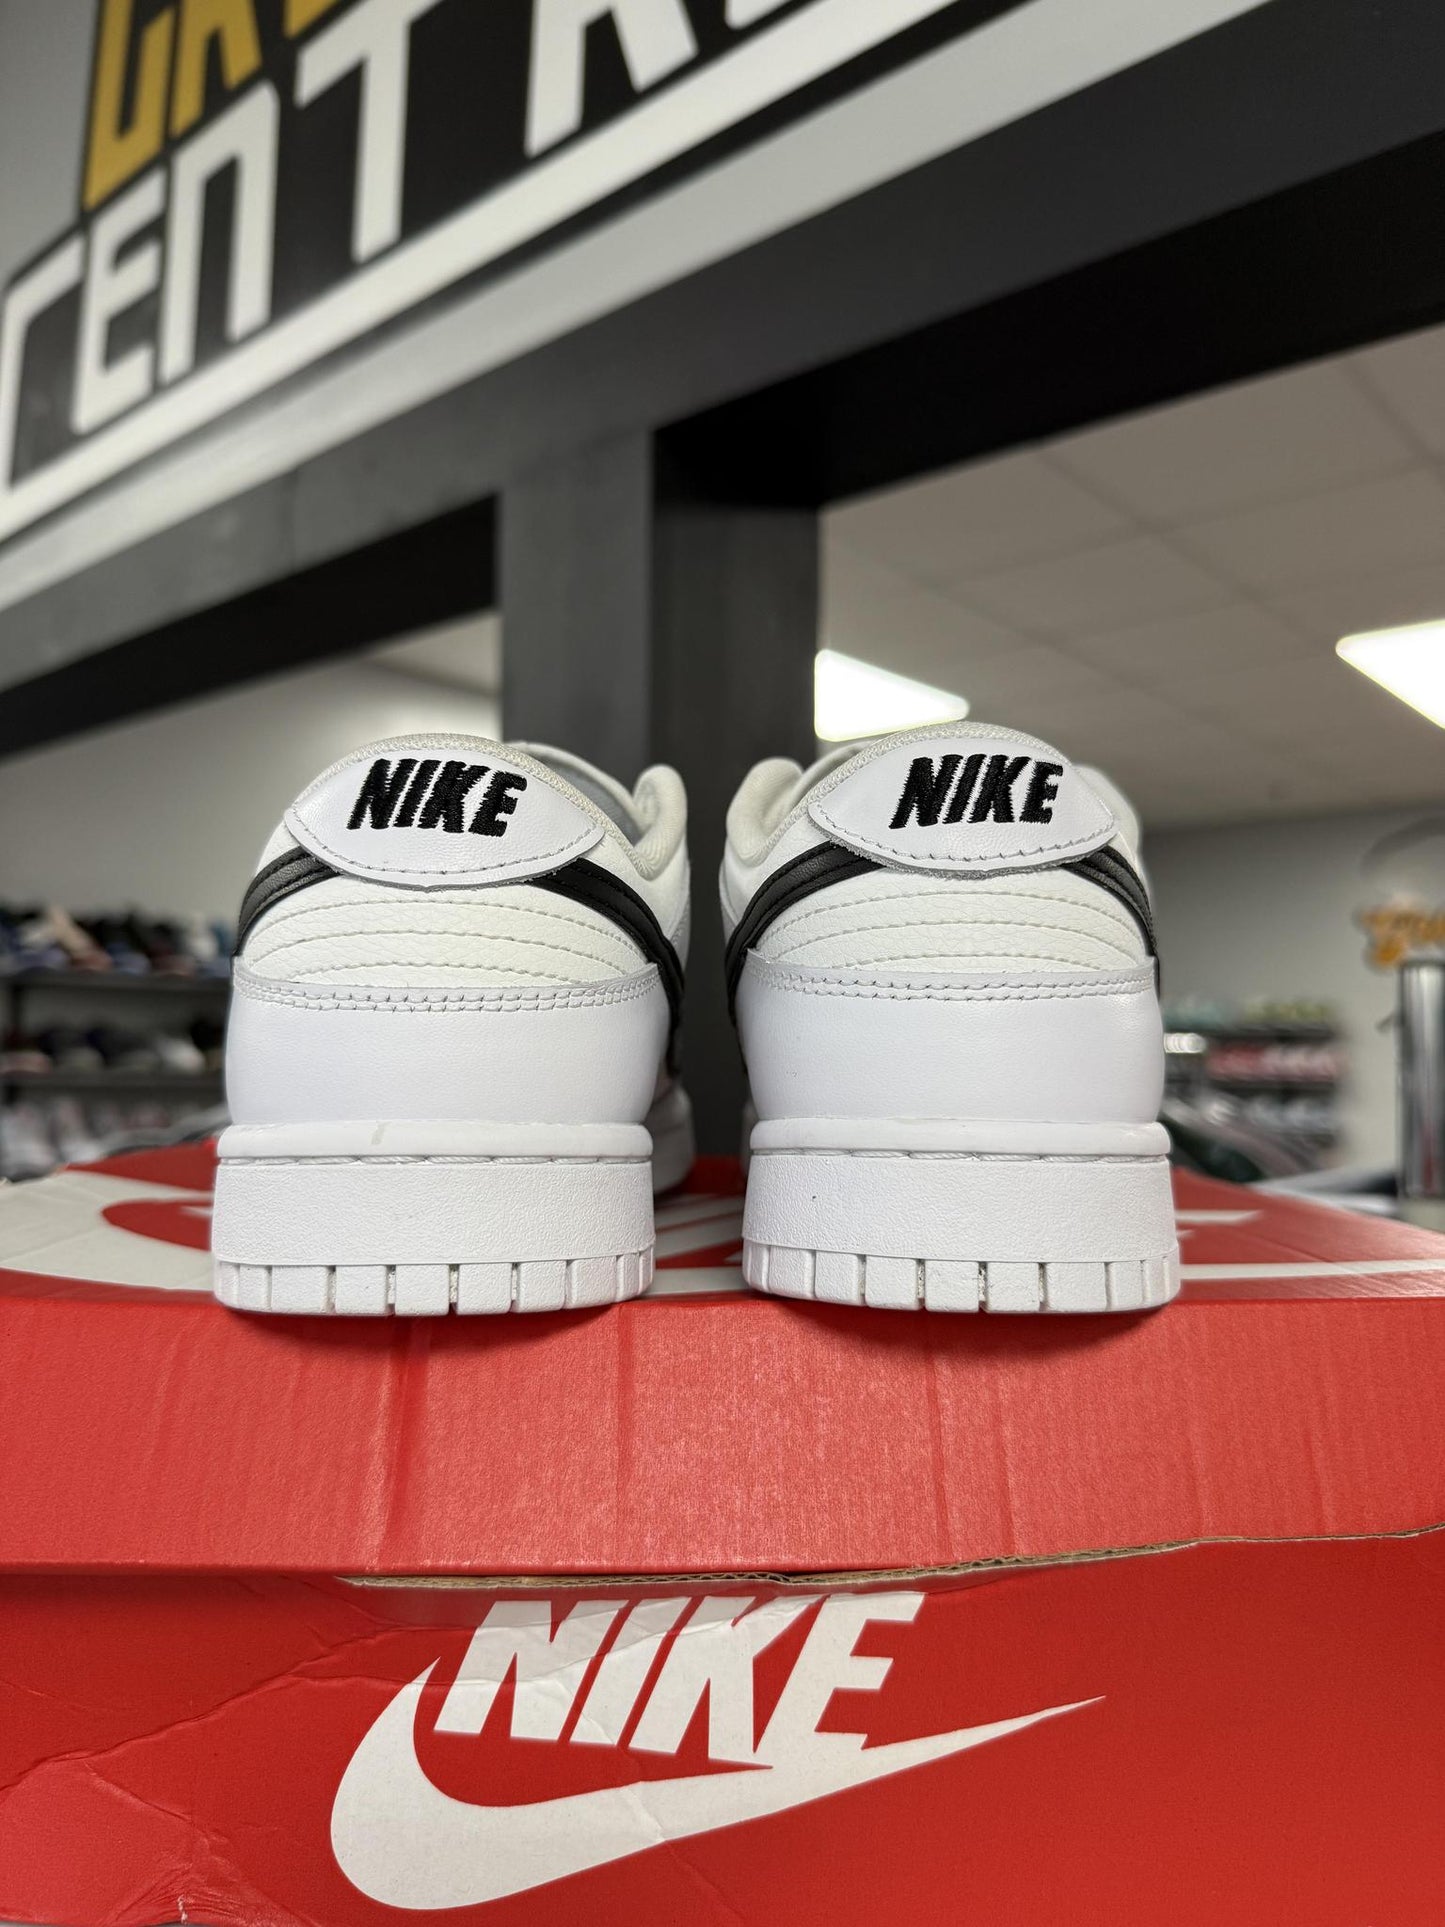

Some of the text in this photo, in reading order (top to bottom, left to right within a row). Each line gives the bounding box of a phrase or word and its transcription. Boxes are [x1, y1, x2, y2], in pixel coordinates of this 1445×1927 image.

[346, 758, 528, 837] NIKE
[888, 754, 1064, 829] NIKE
[434, 1592, 925, 1768] NIKE
